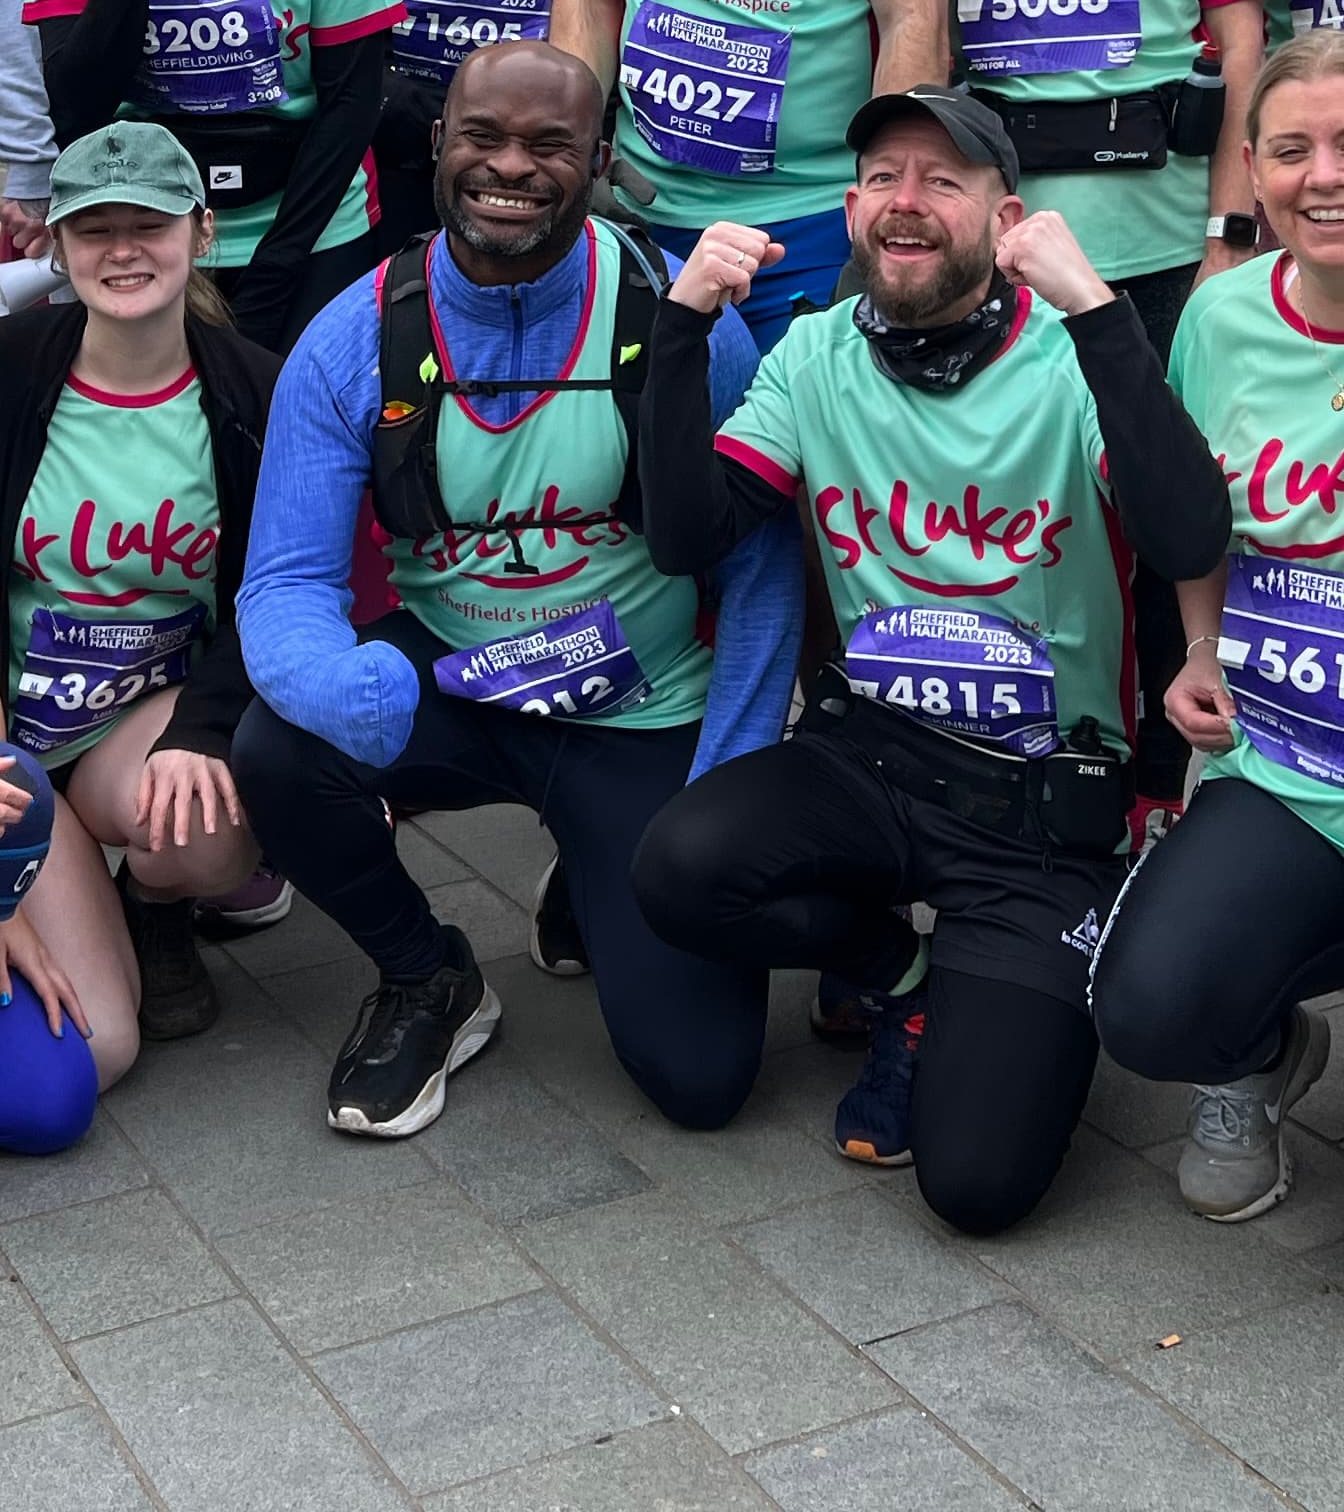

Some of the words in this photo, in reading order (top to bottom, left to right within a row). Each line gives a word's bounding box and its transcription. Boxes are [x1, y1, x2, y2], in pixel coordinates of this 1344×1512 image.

[143, 11, 249, 55] 3208
[425, 11, 523, 47] 1605
[672, 15, 724, 39] SHEFFIELD
[670, 27, 697, 43] HALF
[696, 34, 771, 60] MARATHON
[727, 54, 769, 75] 2023
[248, 85, 283, 104] 3208
[641, 68, 756, 123] 4027
[669, 115, 713, 137] PETER
[815, 485, 882, 570] St
[887, 479, 1073, 568] Luke's
[437, 589, 526, 622] Sheffield's
[1288, 586, 1326, 606] HALF
[912, 610, 977, 628] SHEFFIELD
[90, 626, 153, 639] SHEFFIELD
[90, 638, 123, 649] HALF
[910, 624, 945, 639] HALF
[488, 634, 545, 660] SHEFFIELD
[492, 655, 523, 672] HALF
[523, 627, 599, 664] MARATHON
[562, 638, 606, 669] 2023
[983, 646, 1033, 666] 2023
[885, 675, 1023, 720] 4815
[1077, 763, 1107, 777] ZIKEE
